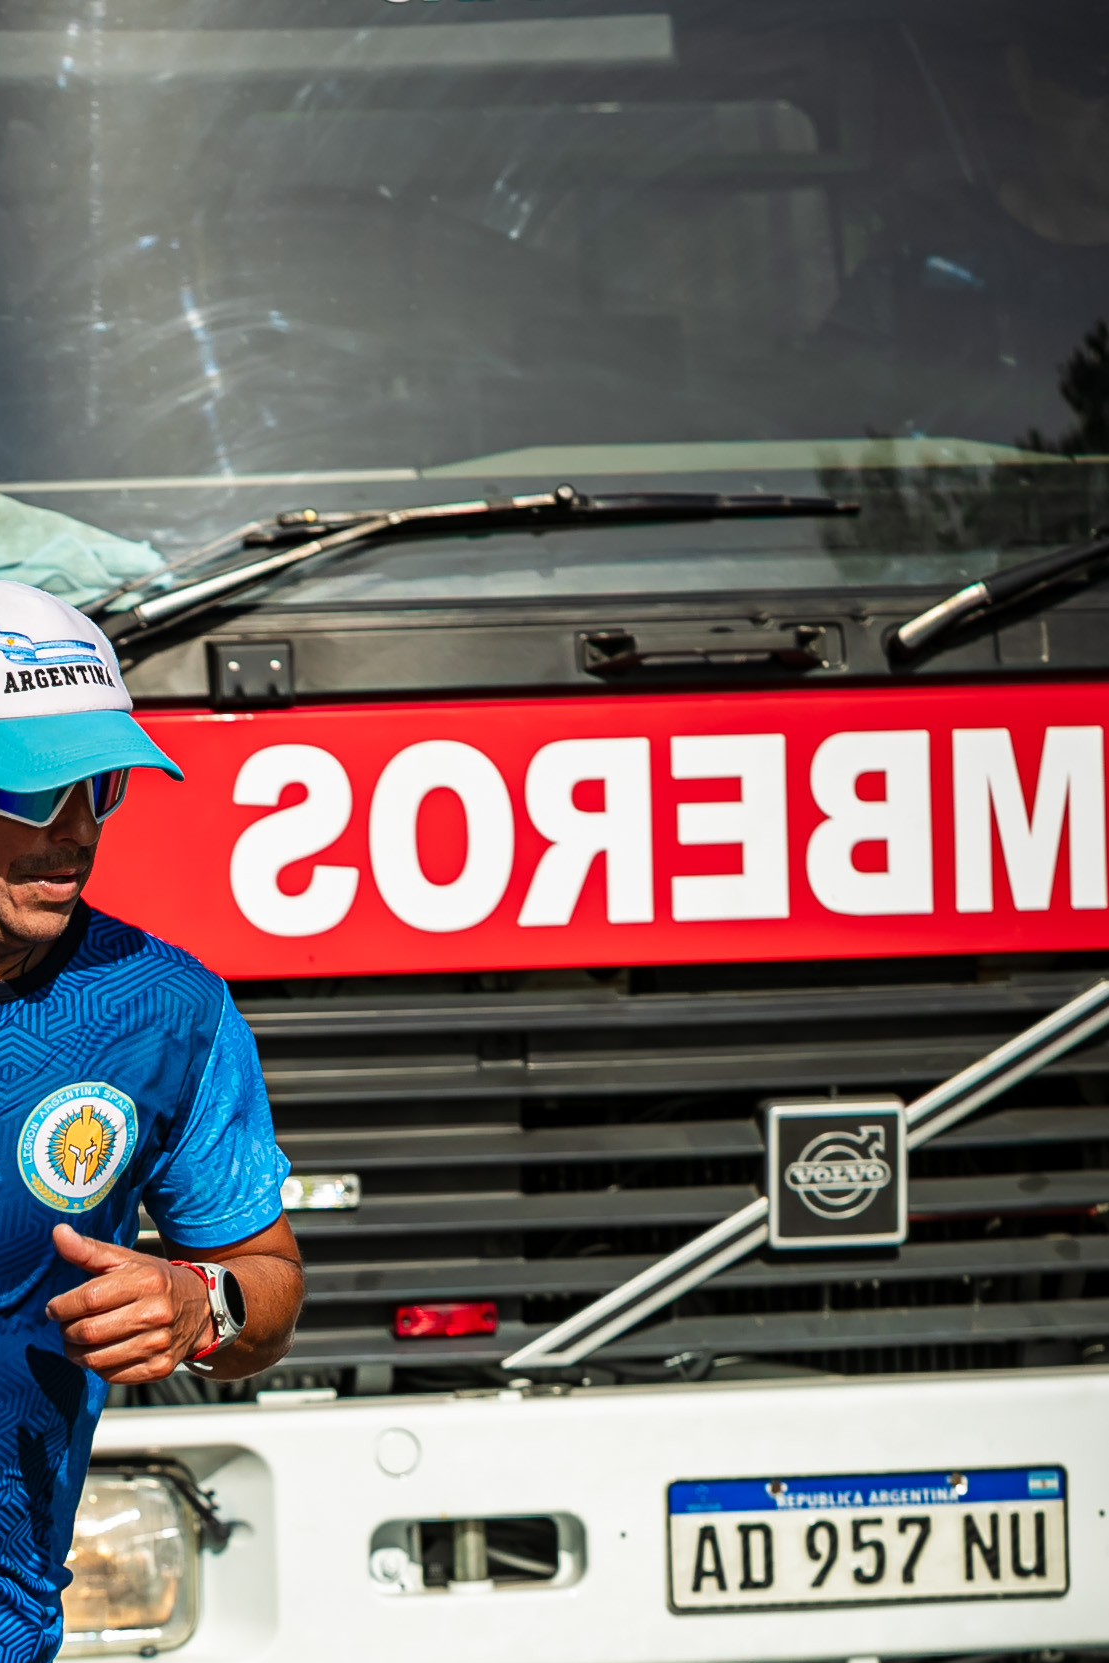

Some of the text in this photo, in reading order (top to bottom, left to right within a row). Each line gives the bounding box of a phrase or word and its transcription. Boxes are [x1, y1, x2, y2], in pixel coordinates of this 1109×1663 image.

[3, 664, 117, 694] ARGENTINA
[24, 1121, 40, 1165] LEGION
[39, 1086, 100, 1120] ARGENTINA
[791, 1164, 885, 1184] VOLVO
[869, 1486, 959, 1505] ARGENTINA
[692, 1512, 1047, 1592] AD 957 NU
